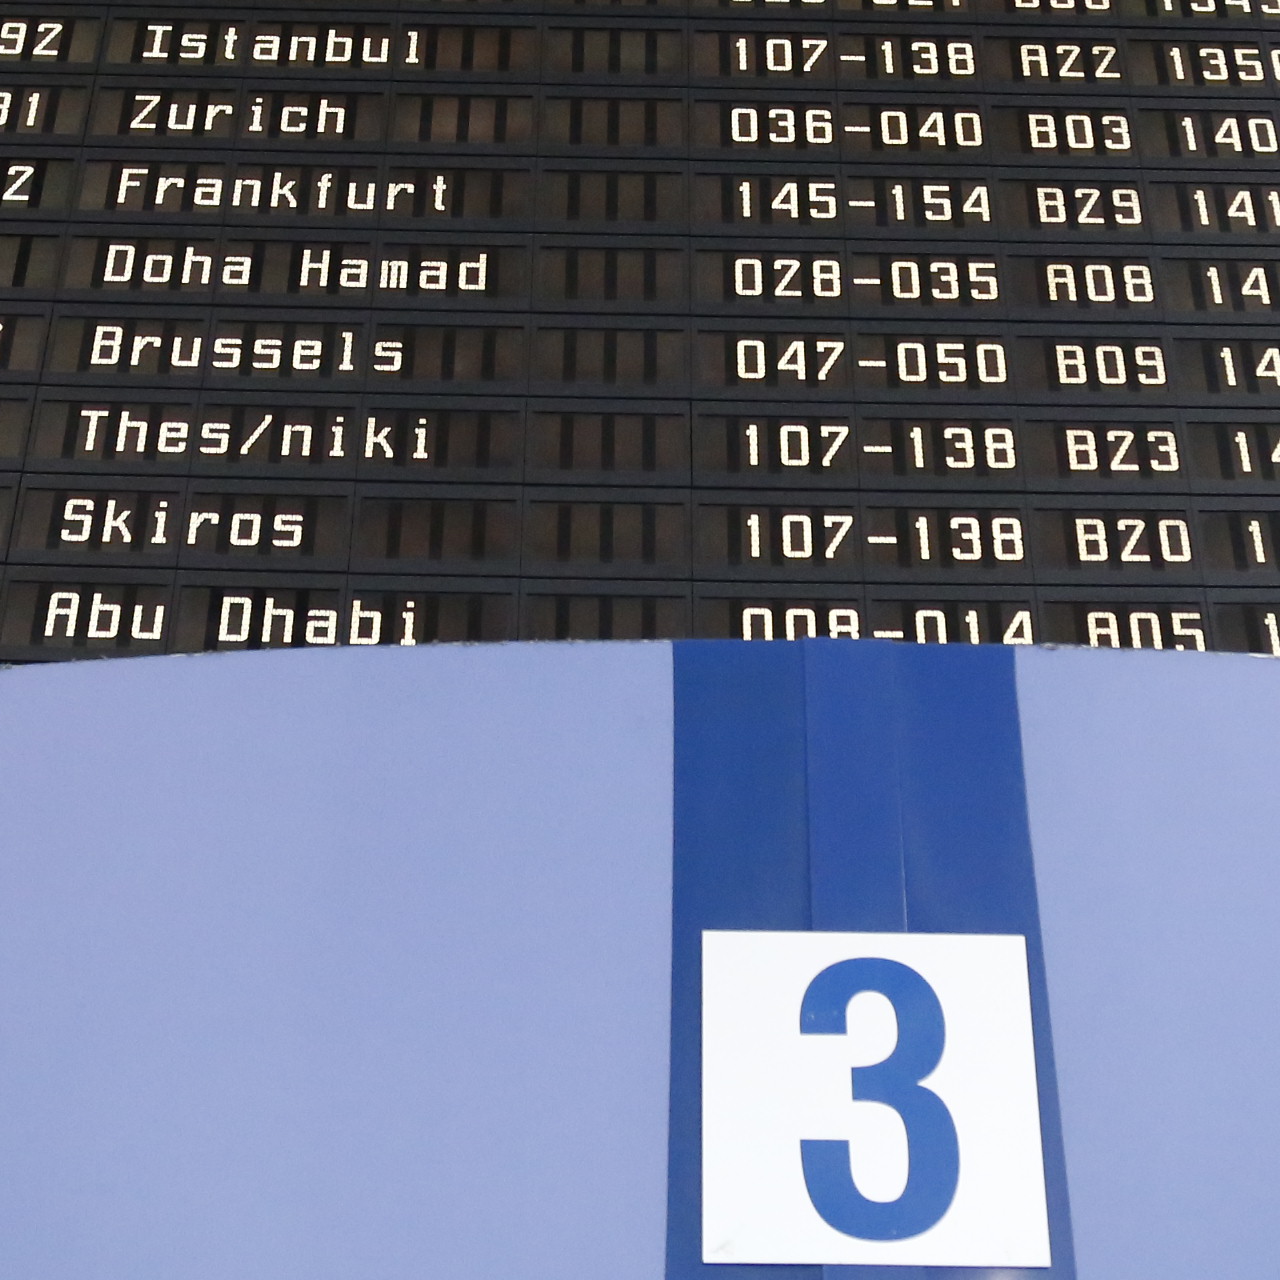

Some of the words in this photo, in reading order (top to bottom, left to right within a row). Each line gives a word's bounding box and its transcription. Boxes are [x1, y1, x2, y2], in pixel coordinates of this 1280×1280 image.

[143, 26, 418, 63] Istanbul
[736, 39, 974, 74] 107-138
[1021, 45, 1120, 77] A22
[91, 326, 402, 371] Brussels
[737, 340, 1006, 382] 047-050
[1056, 345, 1166, 384] B09
[61, 499, 303, 546] Skiros
[747, 514, 1023, 560] 107-138
[1076, 519, 1191, 562] B20
[45, 592, 164, 639] Abu
[219, 597, 416, 645] Dhabi
[800, 957, 960, 1243] 3
